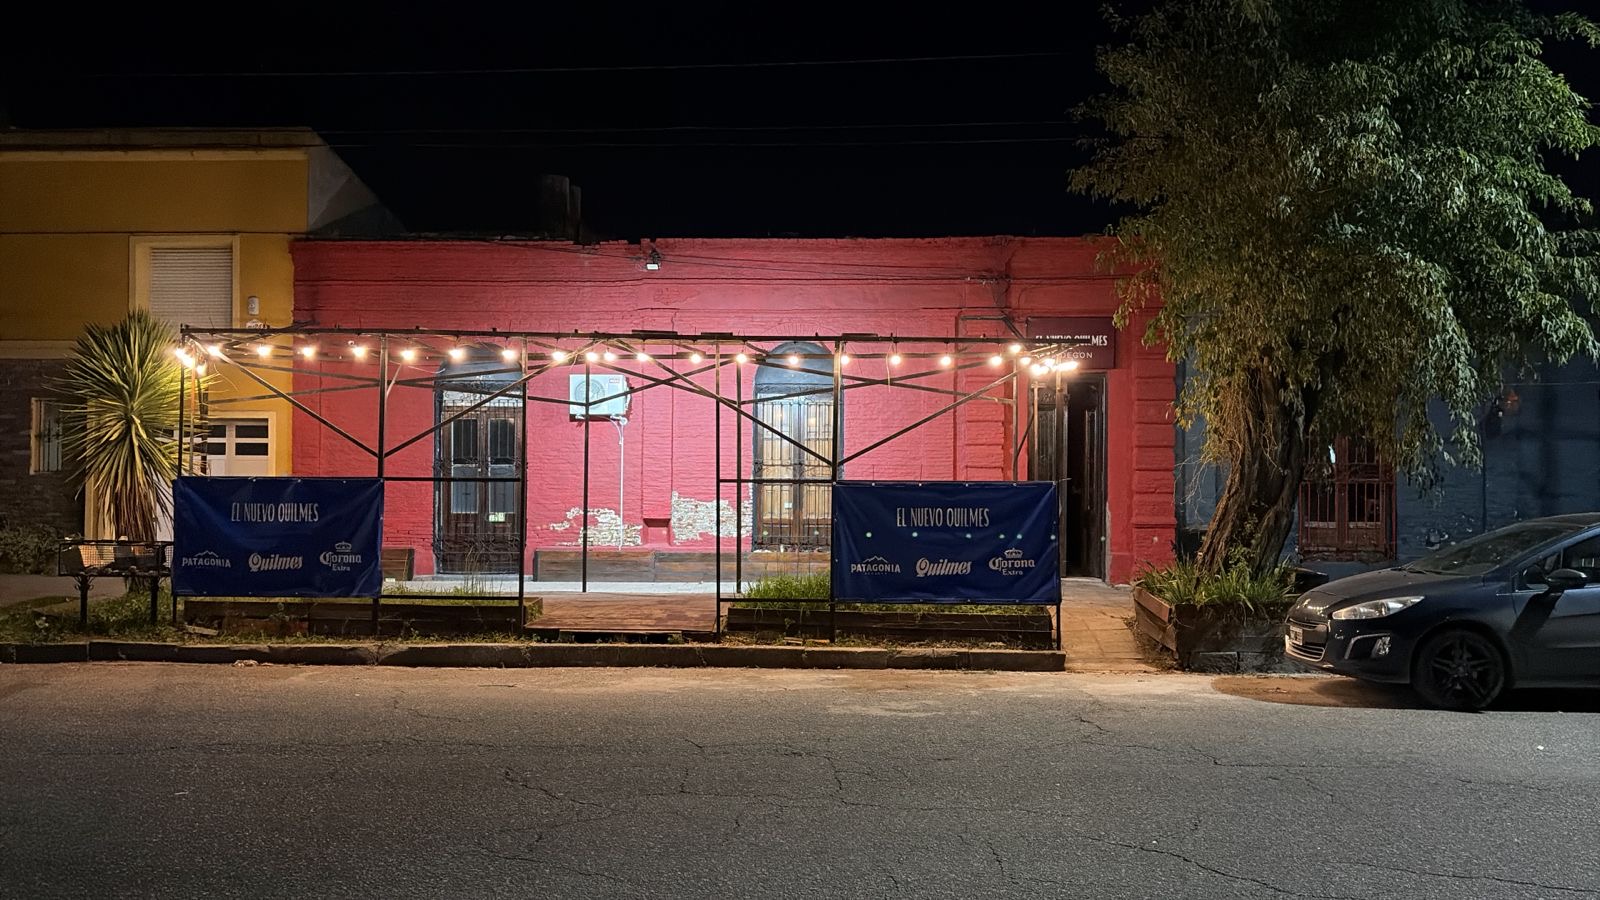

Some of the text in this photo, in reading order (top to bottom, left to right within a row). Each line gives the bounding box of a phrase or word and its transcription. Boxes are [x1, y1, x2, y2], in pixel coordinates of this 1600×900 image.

[1047, 351, 1093, 359] DEGON
[231, 503, 240, 522] EL
[243, 503, 275, 522] NUEVO
[897, 508, 907, 526] EL
[910, 508, 943, 527] NUEVO
[182, 556, 231, 568] PATAGONIA
[249, 553, 303, 572] Quilmes
[319, 551, 362, 566] Corona
[988, 557, 1036, 571] Corona
[332, 563, 350, 571] Extra
[850, 563, 901, 573] PATAGONIA
[915, 557, 972, 577] Quilmes
[1002, 568, 1024, 576] Extra
